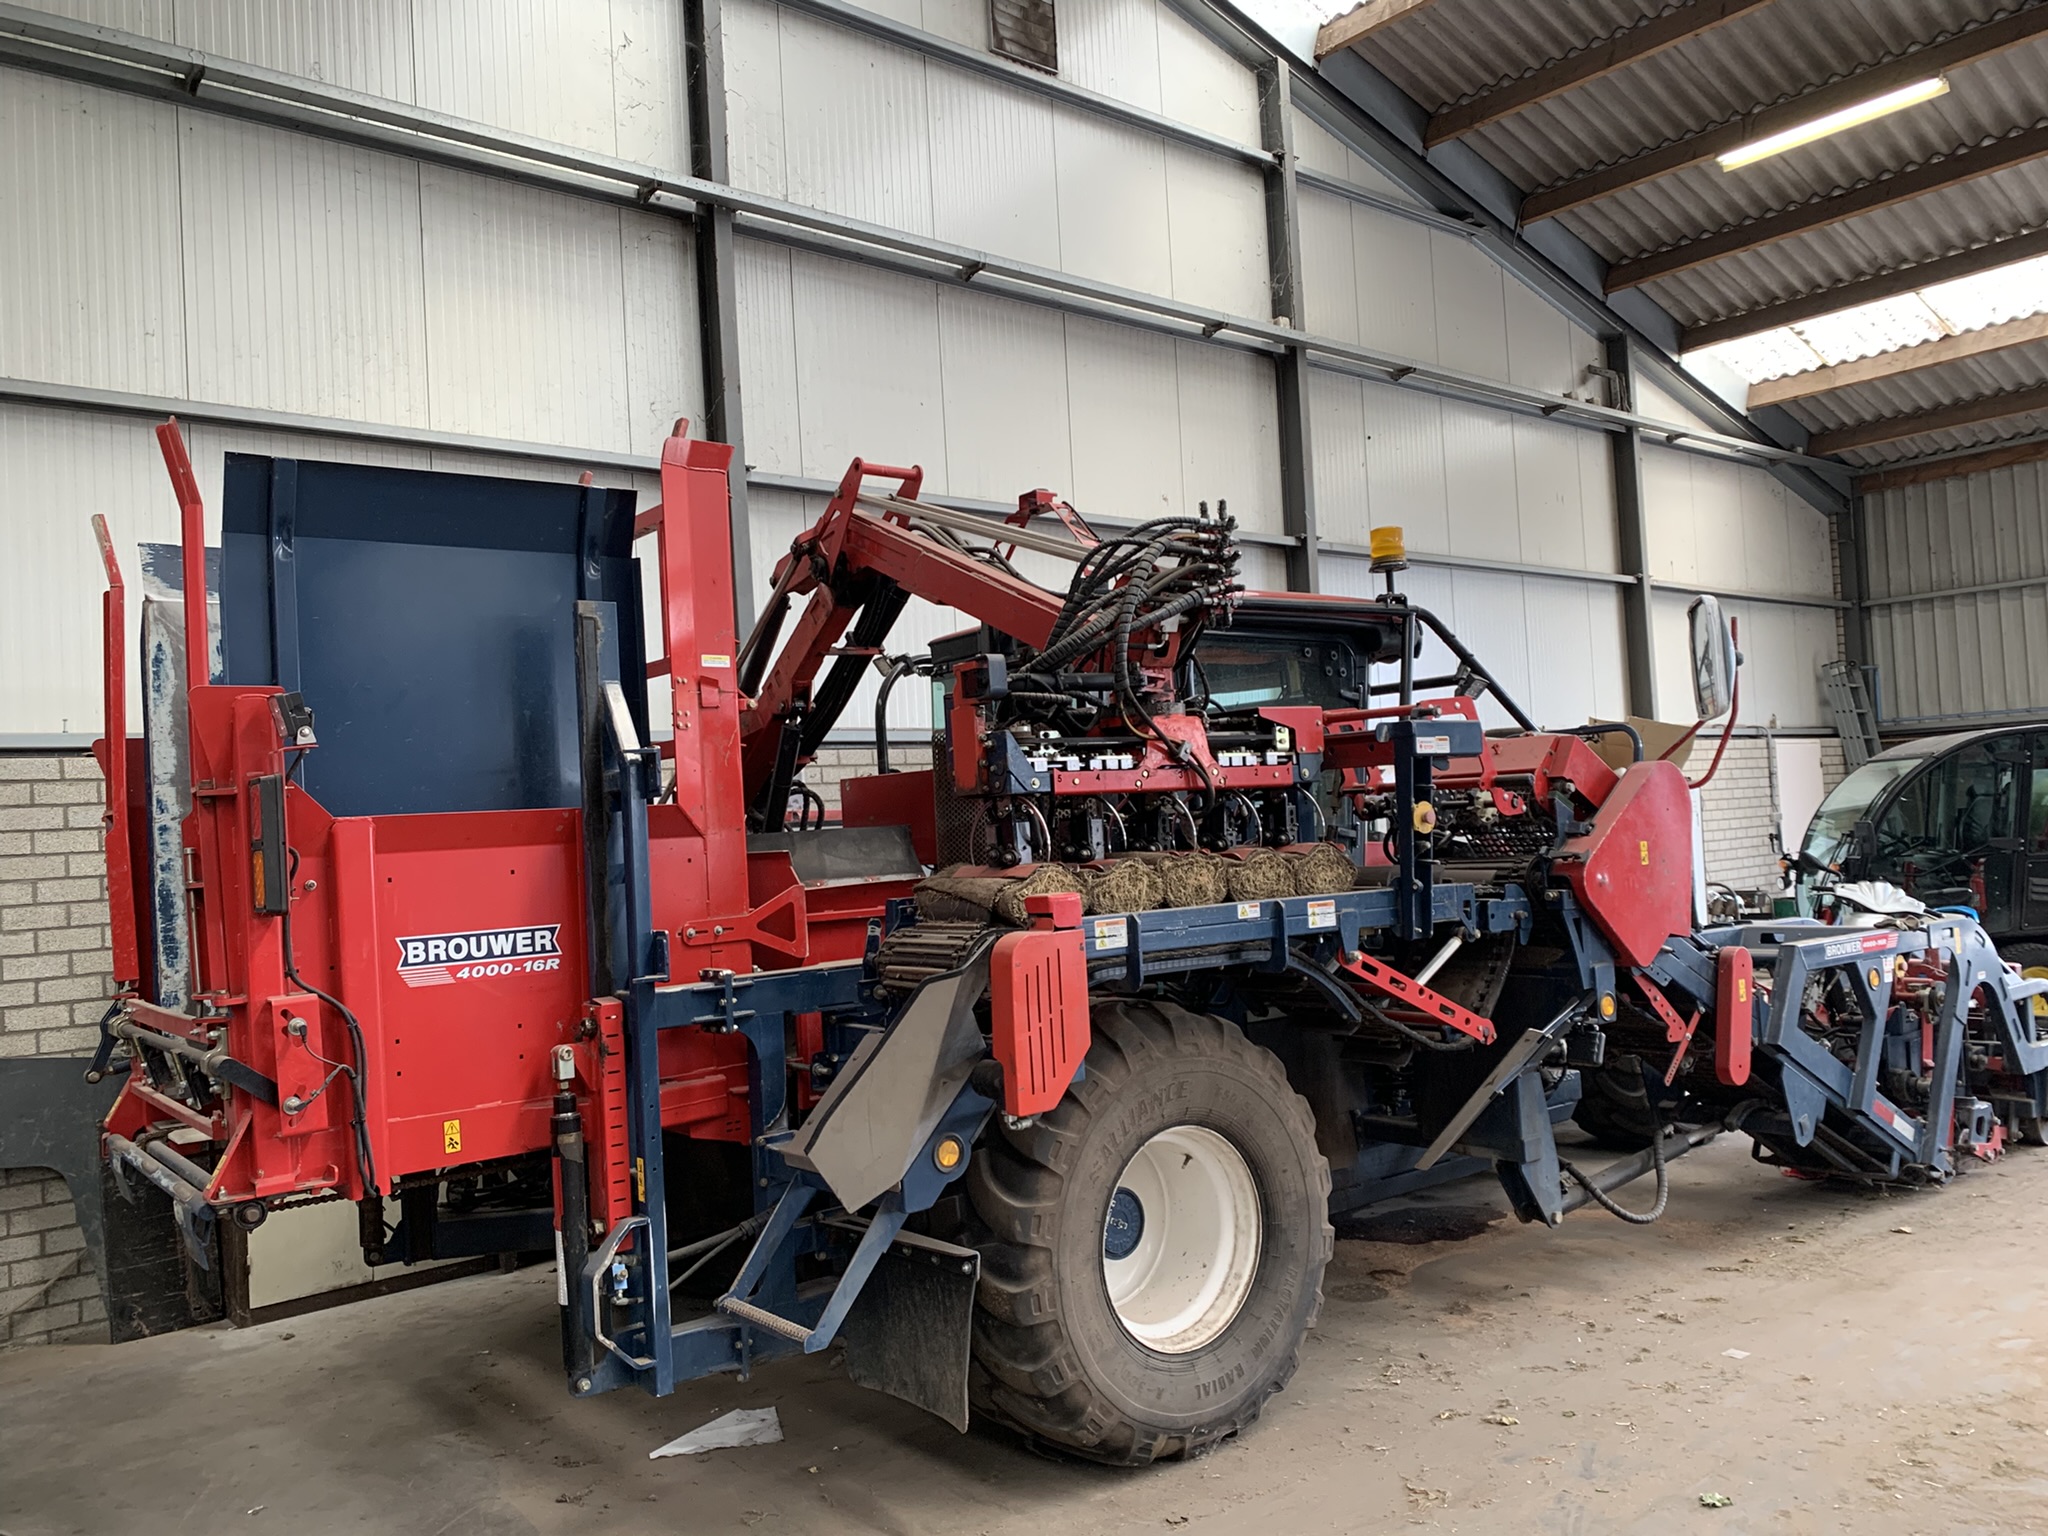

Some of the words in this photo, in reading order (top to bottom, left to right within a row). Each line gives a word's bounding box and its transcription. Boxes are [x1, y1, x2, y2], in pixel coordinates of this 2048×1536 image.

[1057, 774, 1062, 783] 5
[1095, 773, 1101, 781] 4
[1254, 768, 1259, 776] 2
[406, 930, 553, 964] BROUWER
[1826, 941, 1861, 957] BROUWER
[456, 958, 560, 979] 4000-16R
[1101, 1080, 1190, 1160] ALLIANCE
[1194, 1362, 1245, 1400] RADIAL
